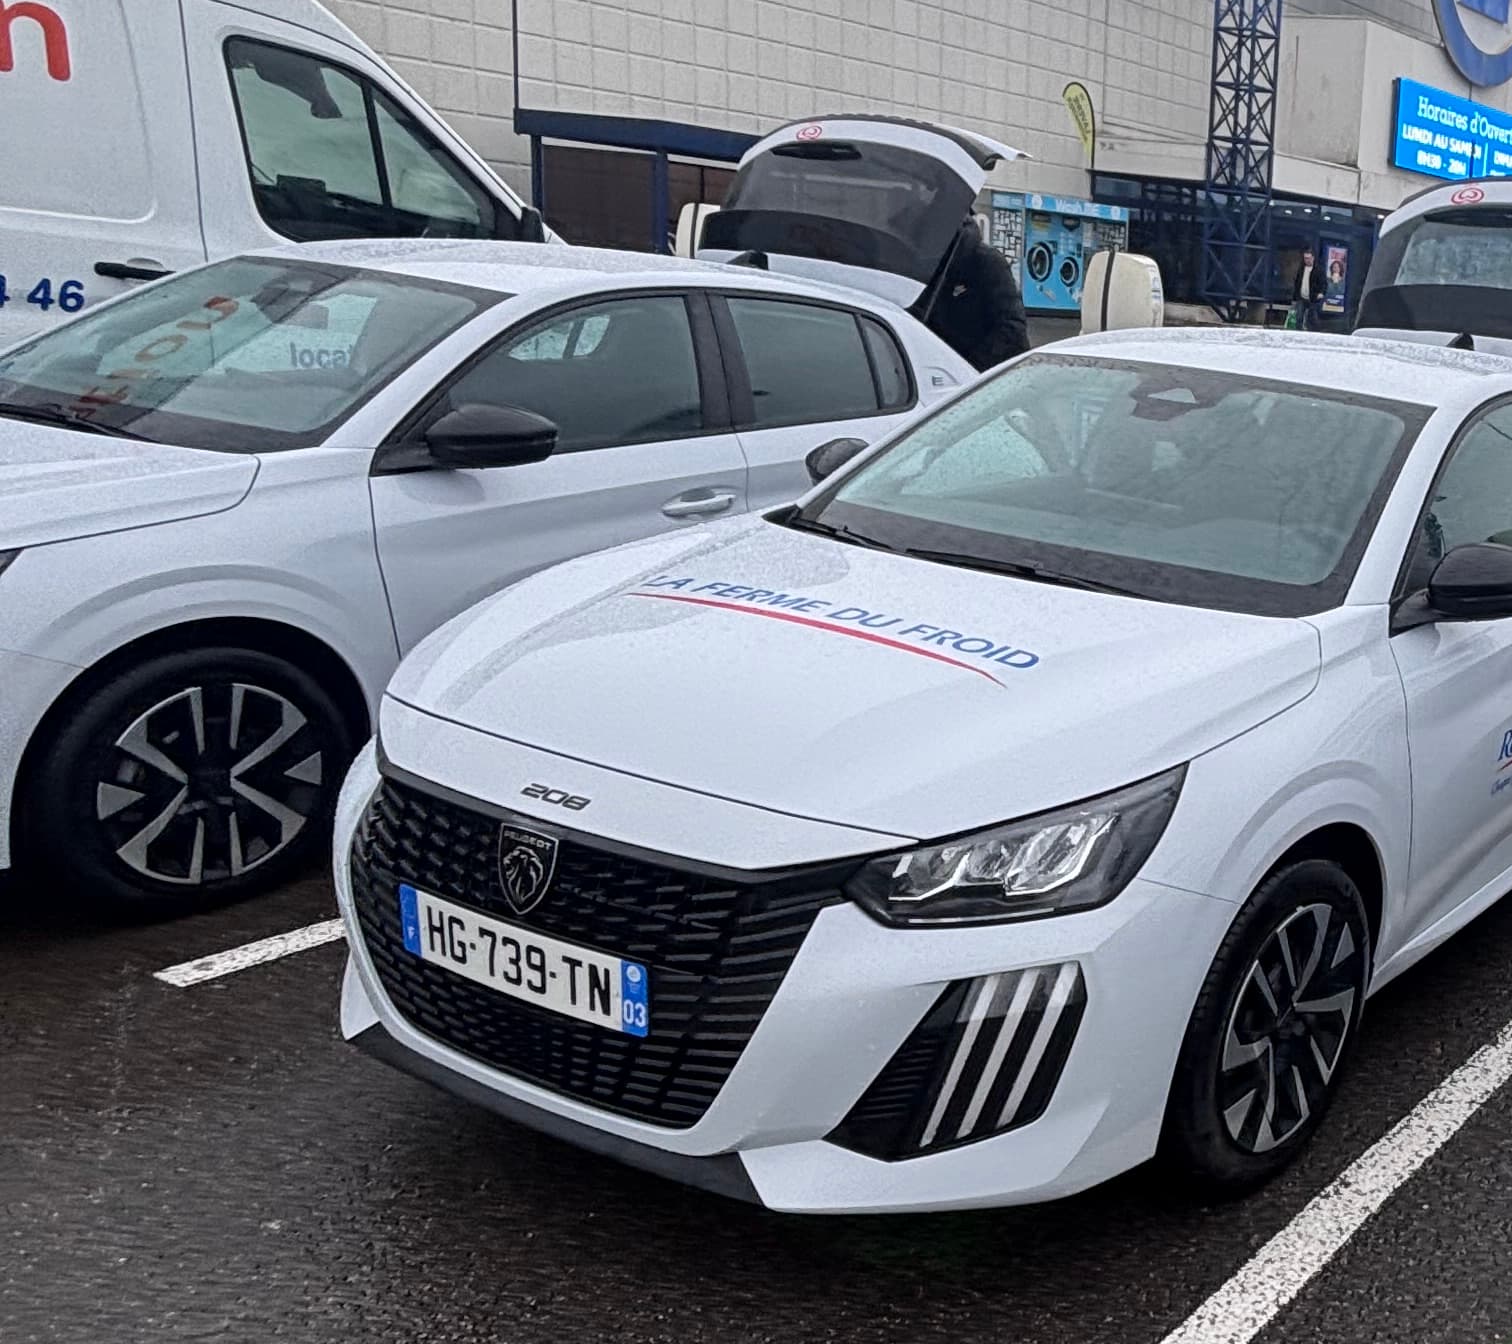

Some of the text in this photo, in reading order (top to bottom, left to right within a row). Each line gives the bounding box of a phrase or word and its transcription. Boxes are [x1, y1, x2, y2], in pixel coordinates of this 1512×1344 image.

[1417, 96, 1467, 130] Horaires
[1403, 123, 1432, 146] LUNDI
[1433, 132, 1449, 150] AU
[27, 278, 84, 313] 46
[642, 575, 1040, 670] LA FERME DU FROID
[521, 783, 591, 810] 208
[426, 904, 611, 1017] HG-739-TN
[623, 999, 647, 1028] 03
